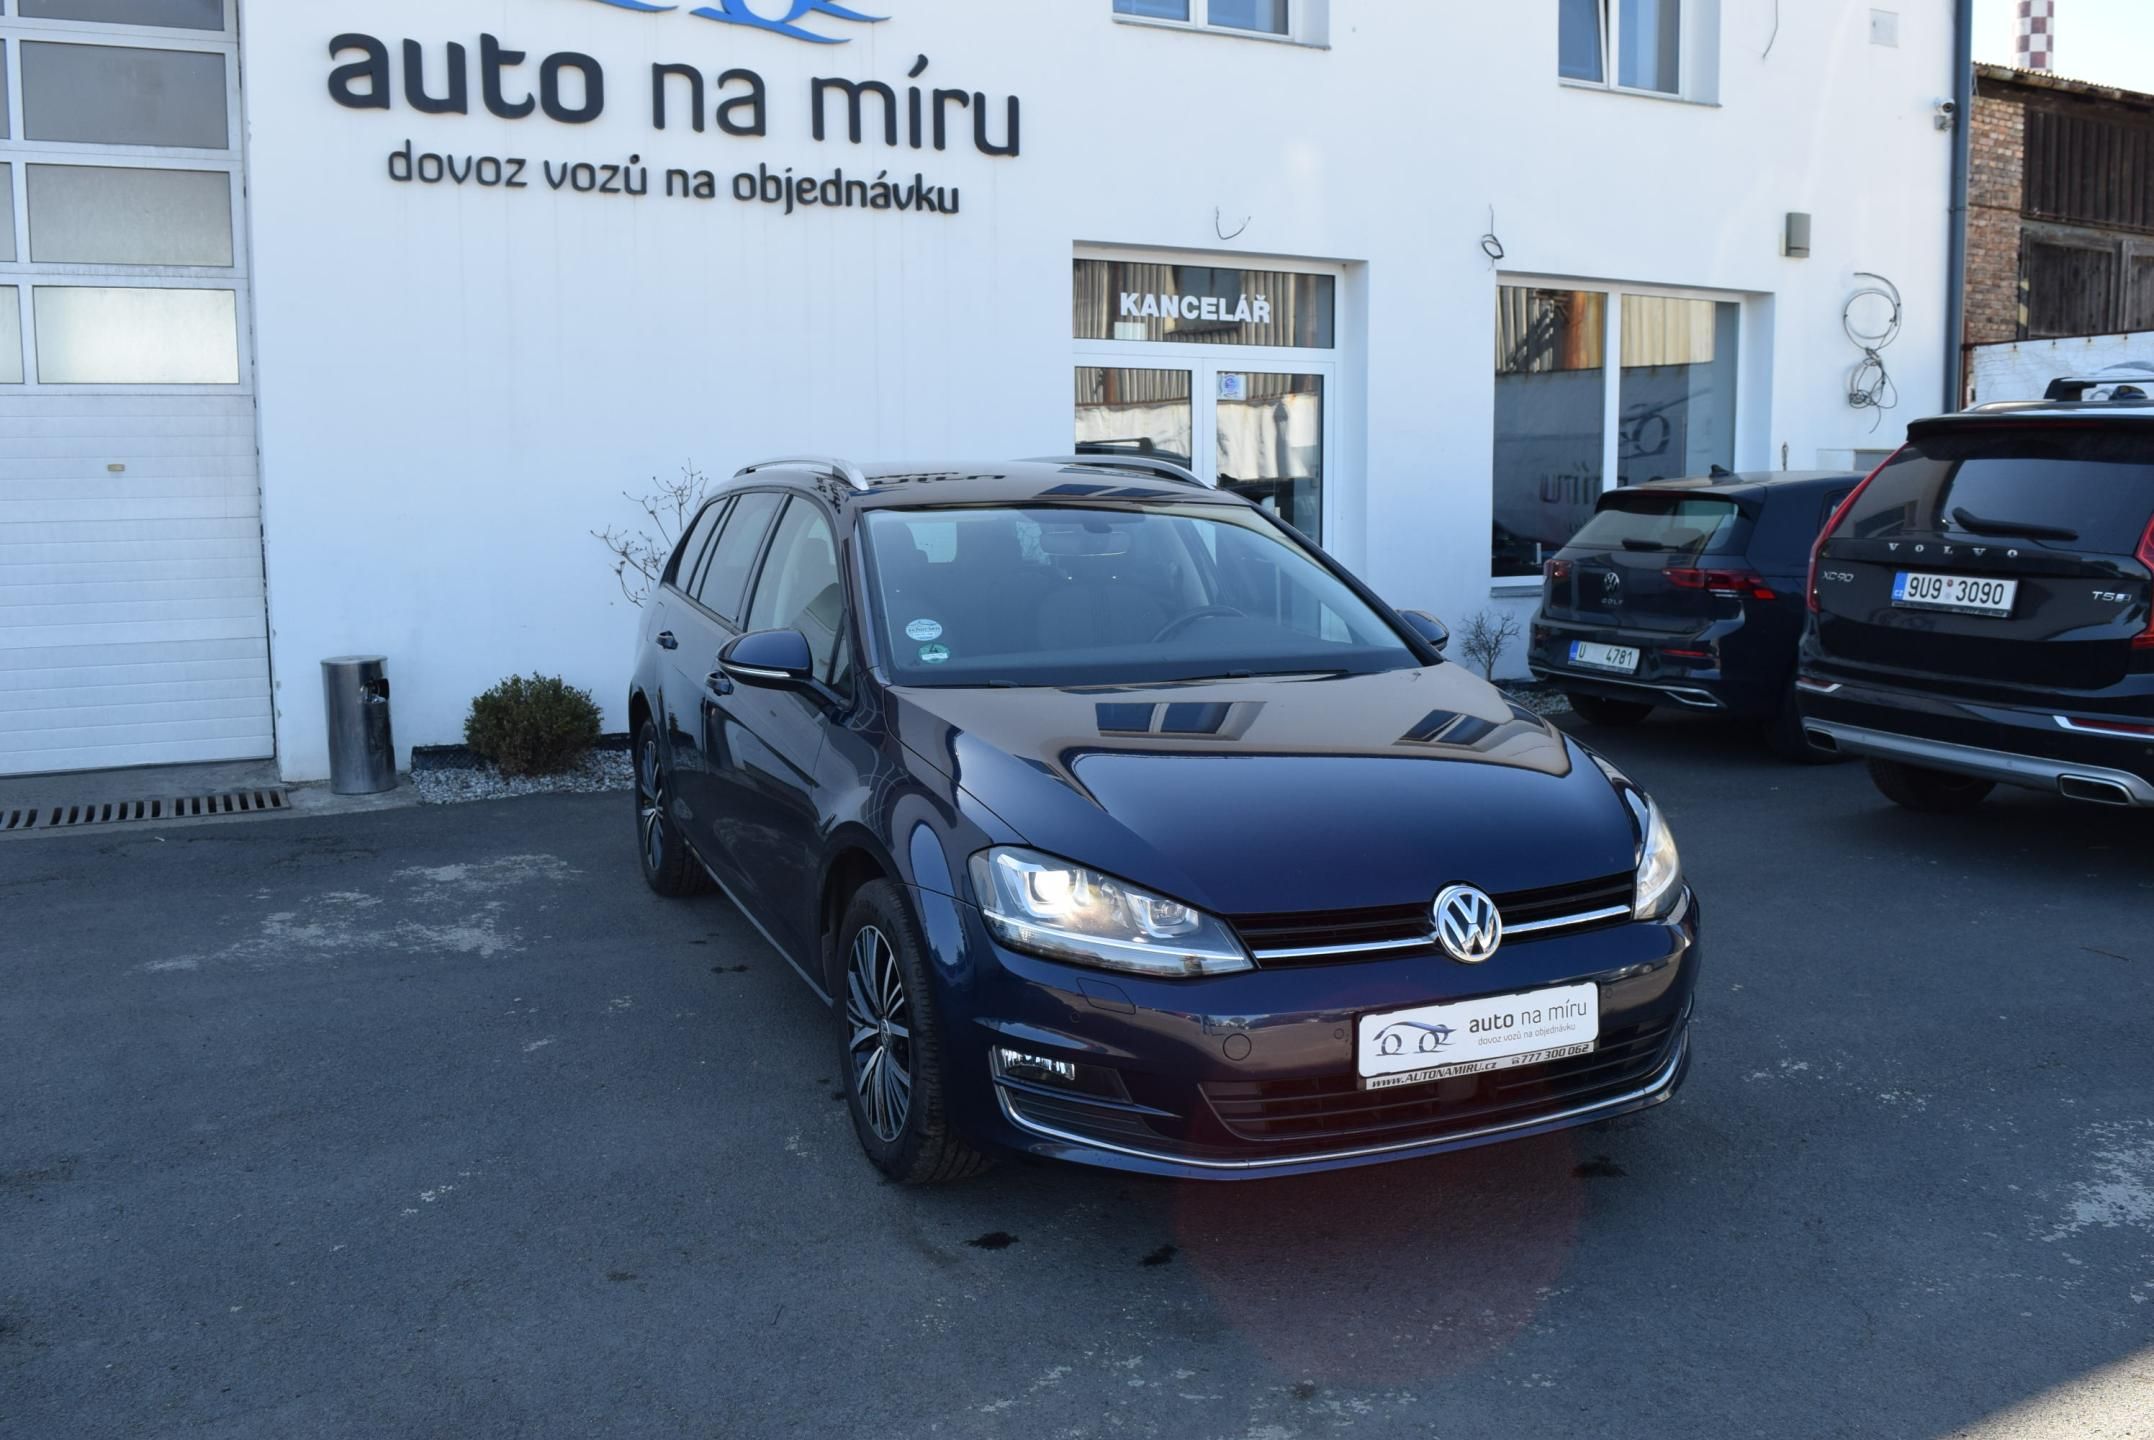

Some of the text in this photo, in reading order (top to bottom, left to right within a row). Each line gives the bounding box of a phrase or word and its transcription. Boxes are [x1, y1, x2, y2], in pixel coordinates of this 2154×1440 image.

[327, 31, 1021, 159] auto na míru
[387, 138, 960, 215] dovoz vozů na objednávku
[1119, 291, 1271, 324] KANCELÁŘ
[1888, 542, 2019, 559] VOLVO
[1821, 570, 1855, 583] XC90
[1907, 576, 1943, 600] 9U9
[1955, 580, 2005, 605] 3090
[1605, 647, 1634, 667] 4781
[1468, 998, 1587, 1033] auto na míru
[1477, 1035, 1502, 1046] dovoz
[1503, 1030, 1522, 1042] vozů
[1534, 1022, 1576, 1037] objednávku
[1371, 1043, 1590, 1088] www.AUTONAMIRU.cz 777 300 062
